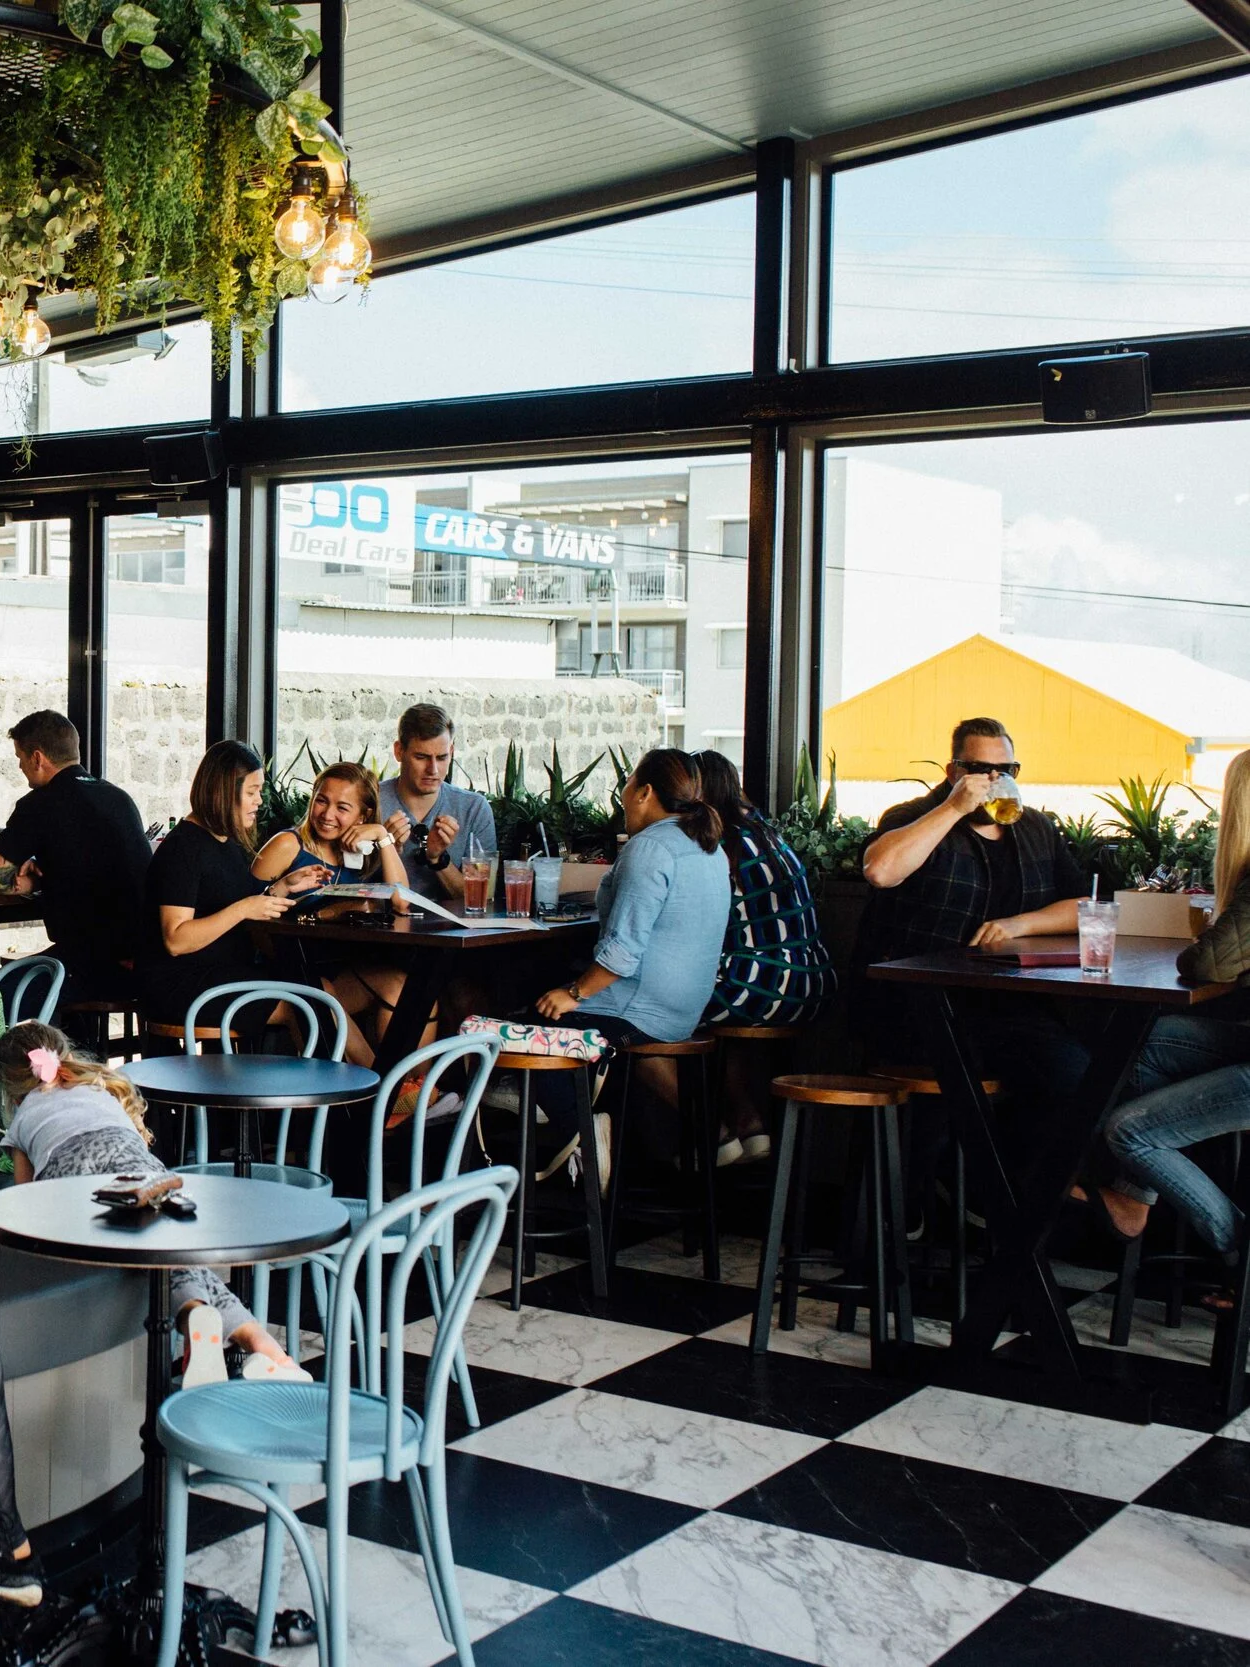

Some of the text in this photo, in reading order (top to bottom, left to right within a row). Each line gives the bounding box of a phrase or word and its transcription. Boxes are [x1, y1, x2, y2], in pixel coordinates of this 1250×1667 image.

[290, 531, 410, 563] Deal Cars
[425, 513, 616, 564] CARS & VANS
